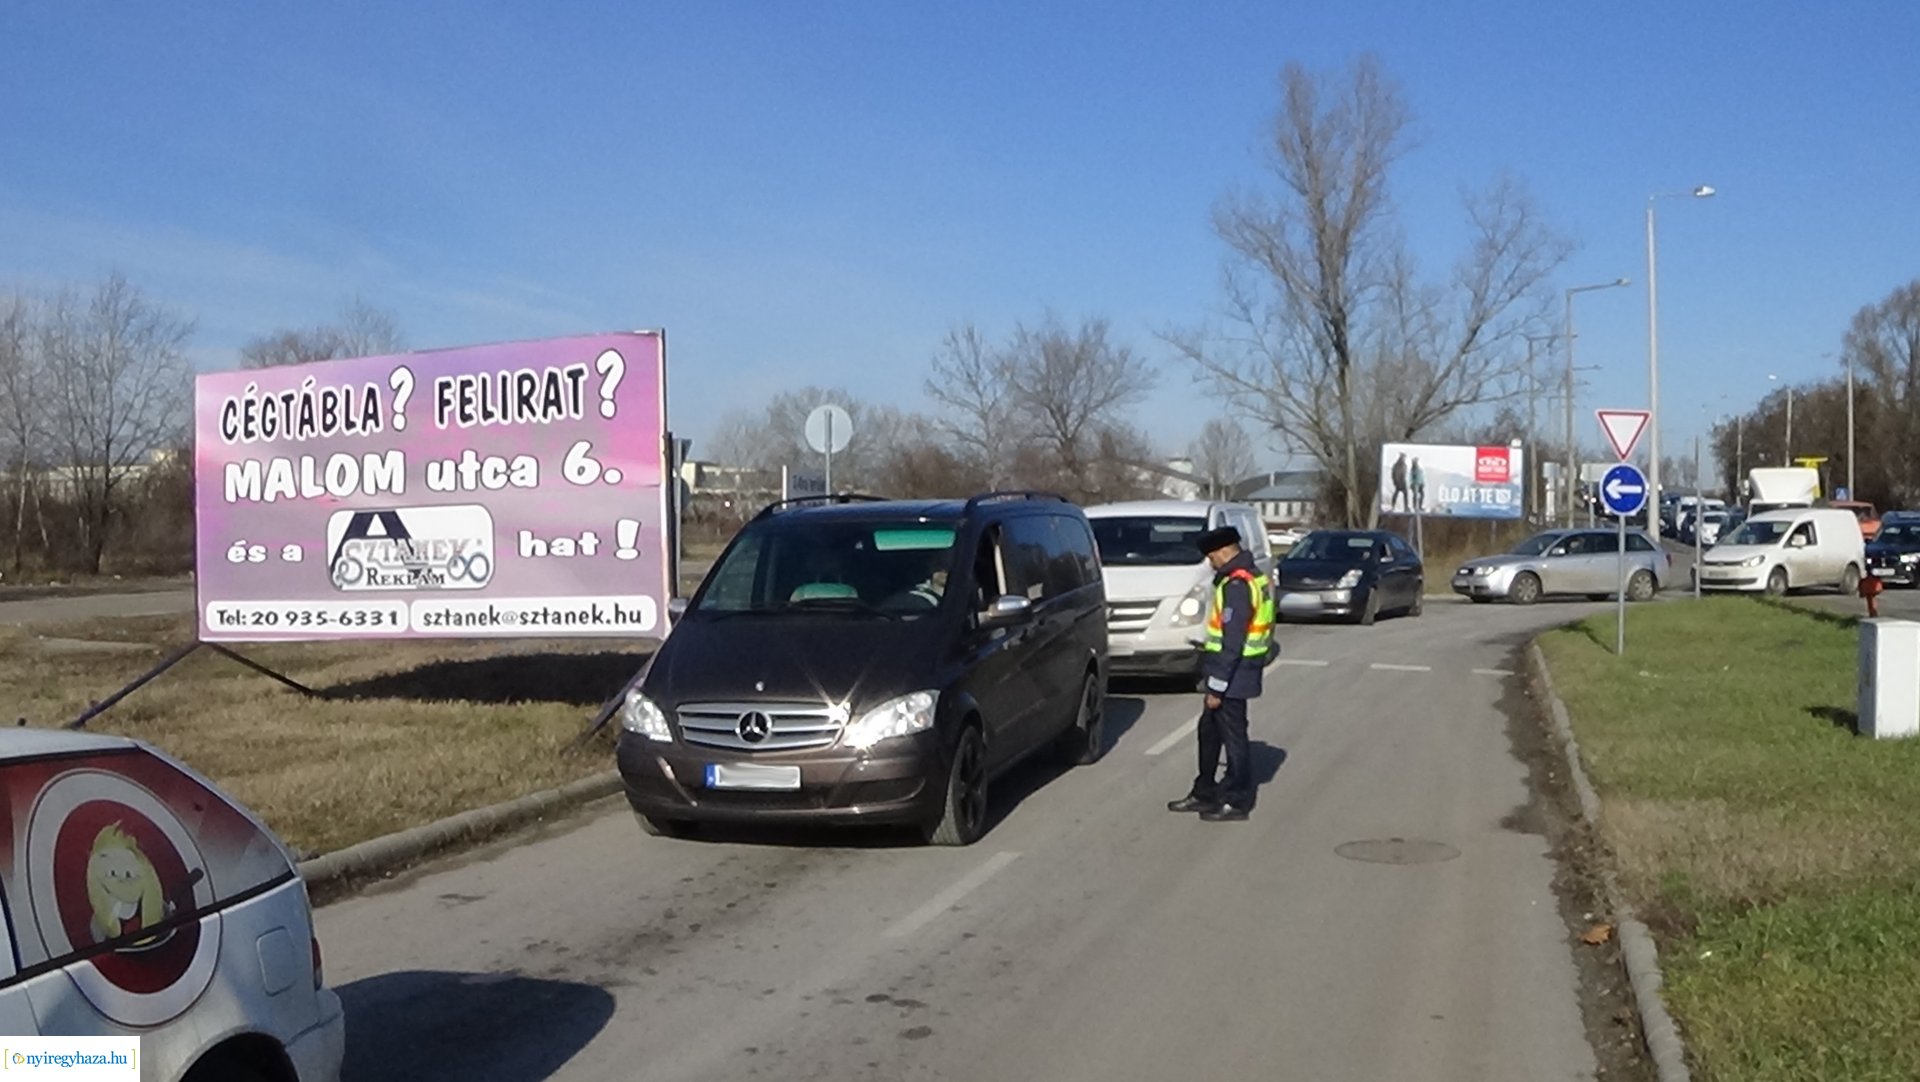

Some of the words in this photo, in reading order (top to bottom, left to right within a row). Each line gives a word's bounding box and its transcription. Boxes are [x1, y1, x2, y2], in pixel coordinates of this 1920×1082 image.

[220, 365, 415, 444] CÉGTÁBLA?
[435, 348, 626, 428] FELIRAT?
[224, 450, 406, 503] MALOM
[426, 448, 540, 491] utca
[562, 439, 623, 486] 6.
[226, 539, 268, 563] és
[281, 543, 304, 562] a
[285, 609, 398, 627] 935-6331
[423, 603, 643, 627] sztanek@sztanek.hu
